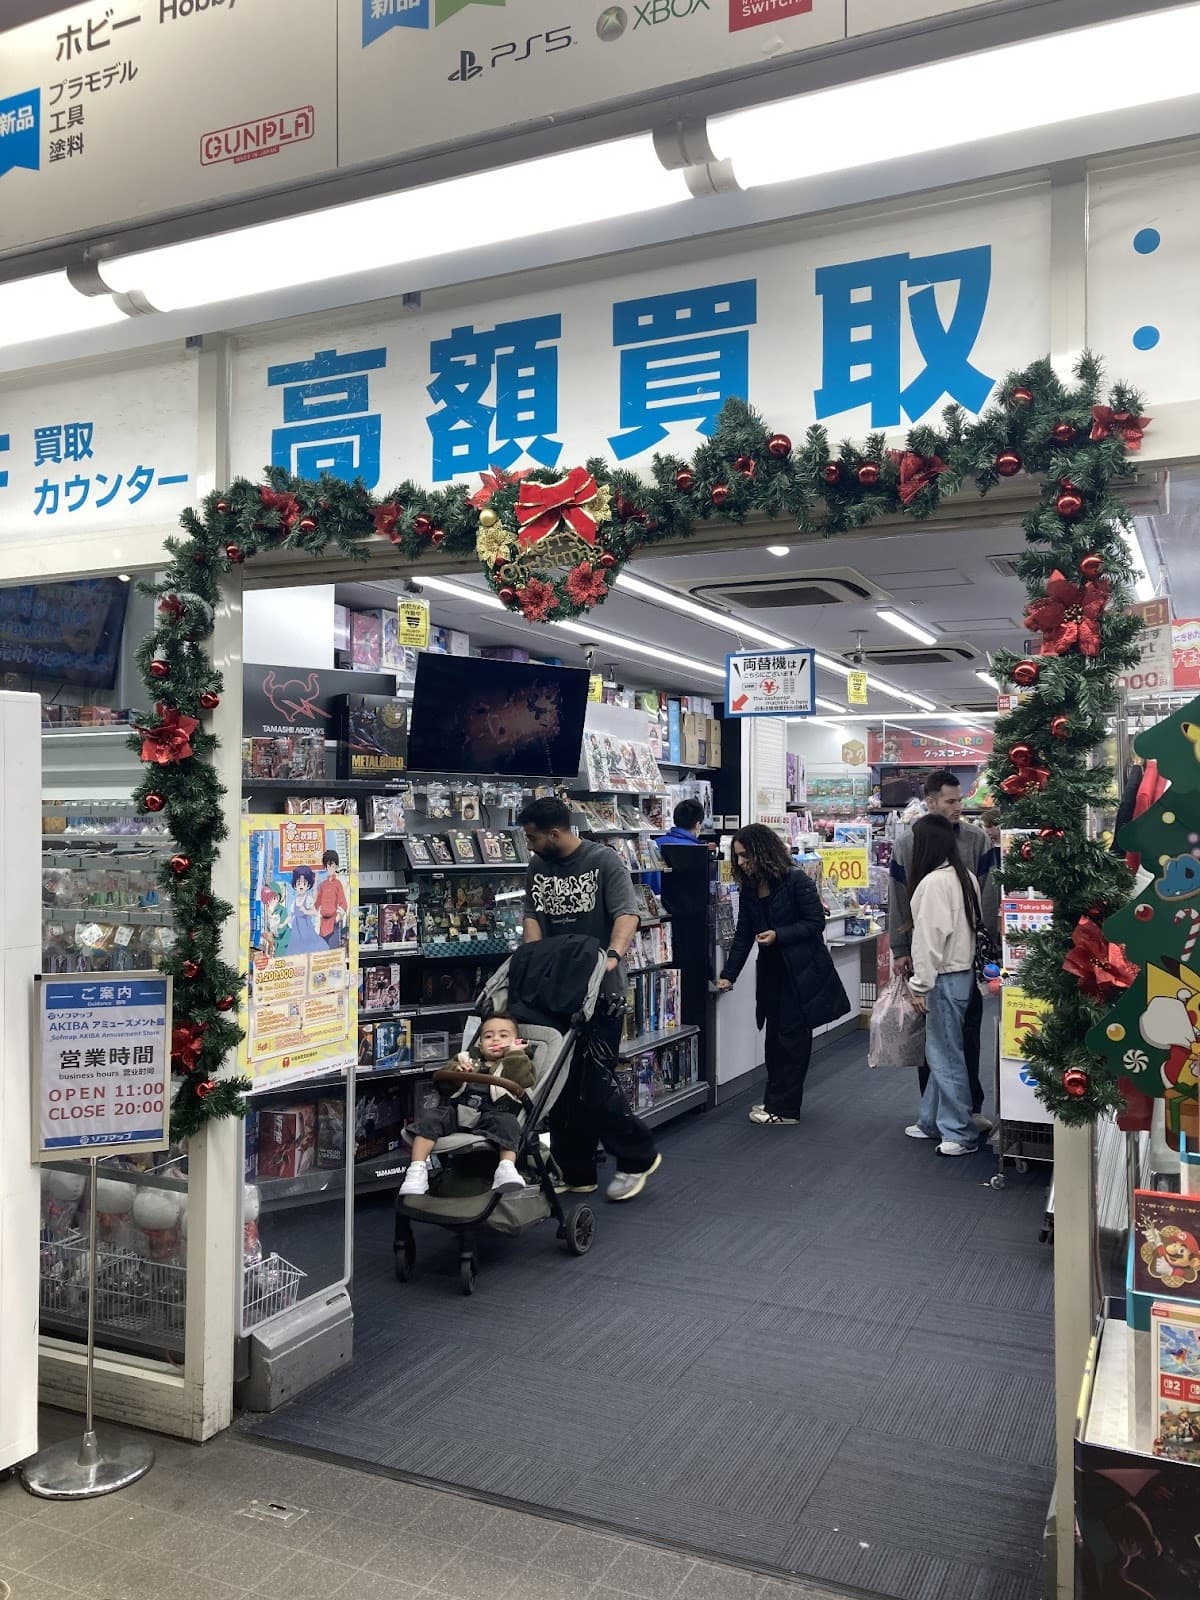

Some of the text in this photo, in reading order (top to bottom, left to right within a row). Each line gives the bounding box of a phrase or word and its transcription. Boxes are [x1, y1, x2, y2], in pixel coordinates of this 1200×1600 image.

[742, 0, 800, 17] SWITC
[55, 8, 141, 61] ホビー
[491, 25, 573, 68] PS5
[49, 60, 138, 106] プラモデル
[0, 104, 34, 137] 新品
[49, 104, 84, 134] 工具
[49, 133, 84, 163] 塗料
[205, 112, 310, 160] GUNPLA
[33, 422, 94, 467] 買取
[33, 465, 189, 515] カウンター
[743, 656, 797, 672] 両替機は
[828, 860, 862, 887] 680
[81, 986, 132, 1000] ご案内
[49, 1021, 89, 1032] AKIBA
[59, 1045, 154, 1070] 営業時間
[96, 1070, 119, 1078] hours
[48, 1082, 164, 1102] OPEN 11:00
[48, 1100, 164, 1121] CLOSE 20:00
[91, 1132, 132, 1142] ソフマップ
